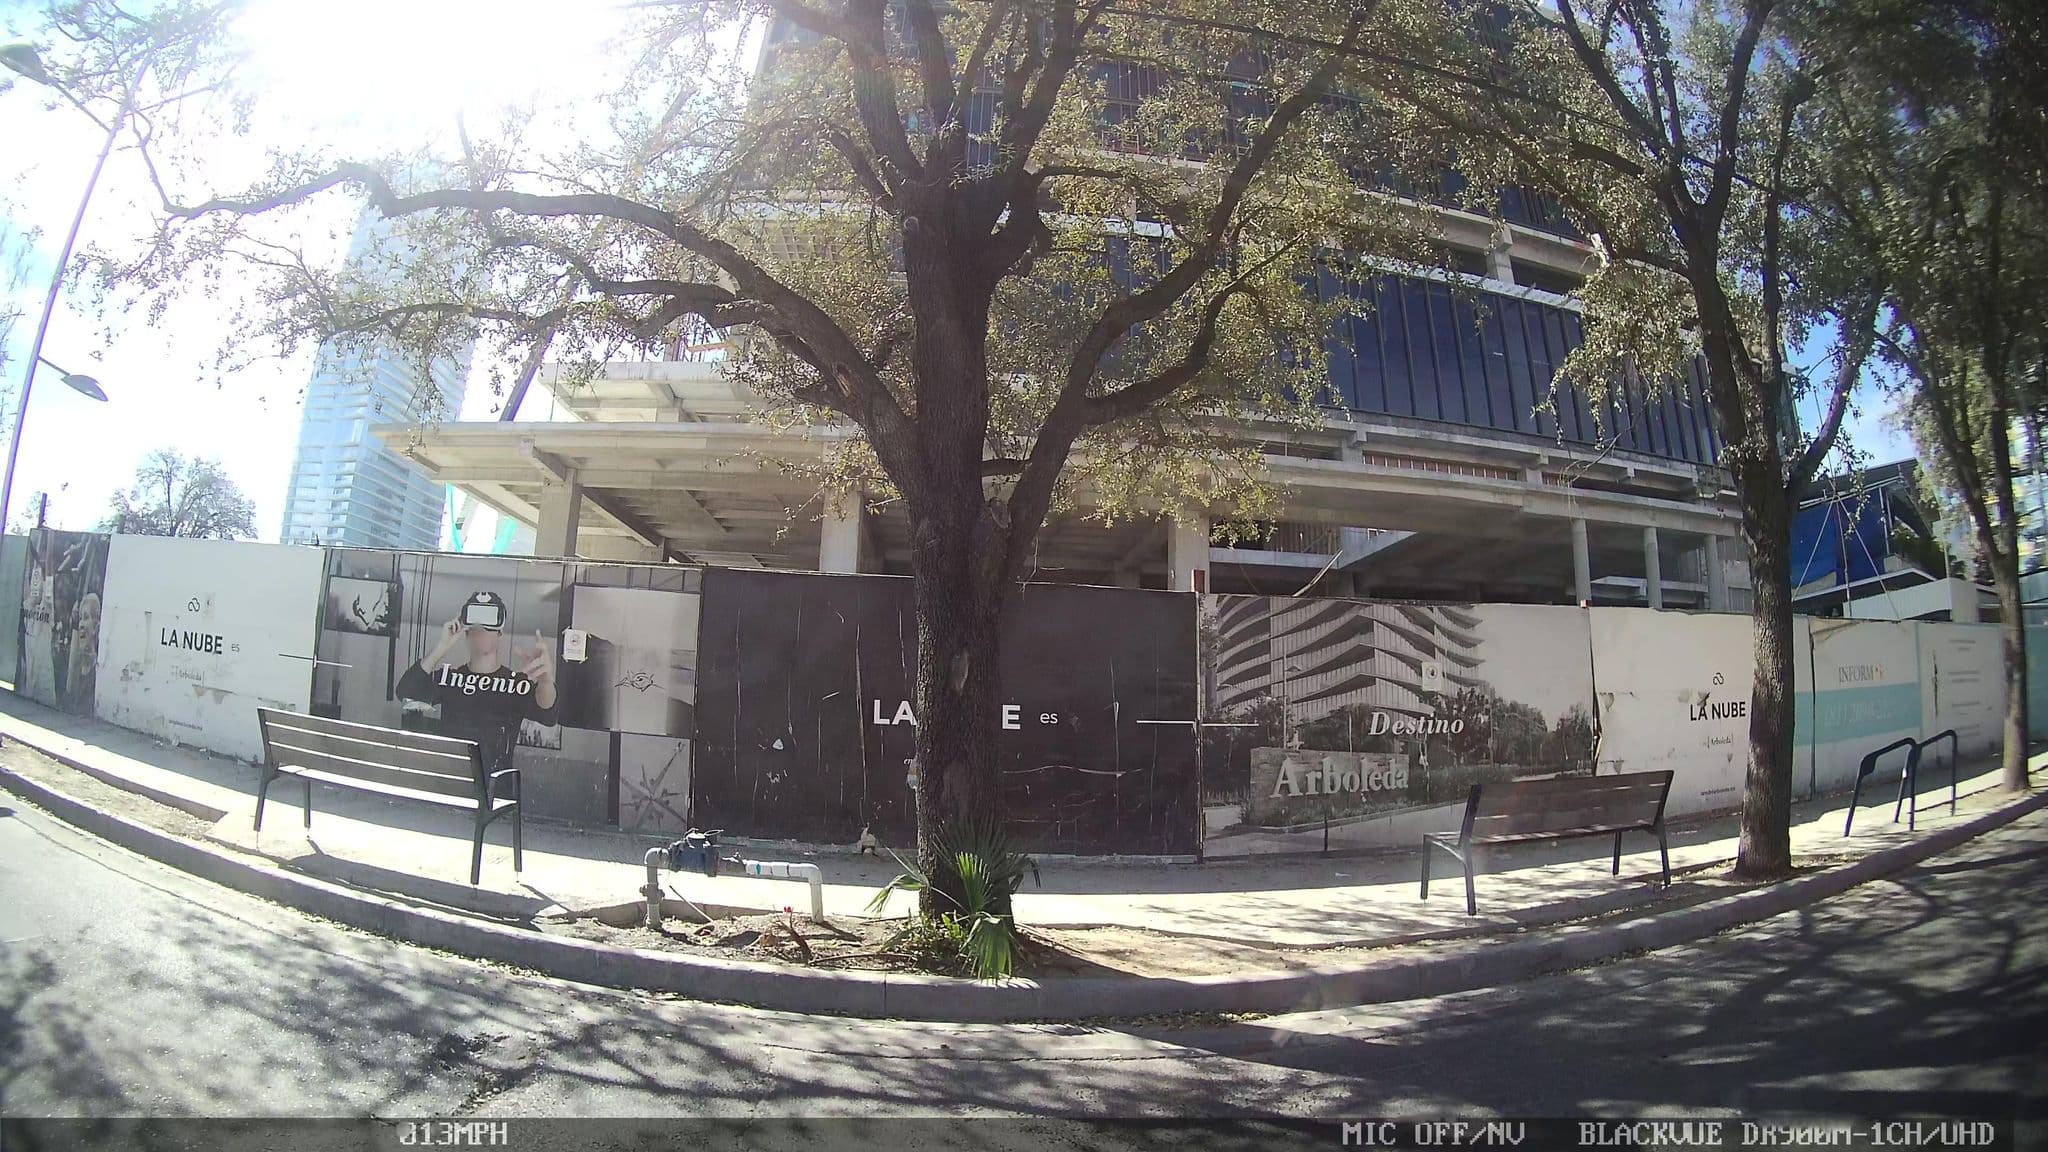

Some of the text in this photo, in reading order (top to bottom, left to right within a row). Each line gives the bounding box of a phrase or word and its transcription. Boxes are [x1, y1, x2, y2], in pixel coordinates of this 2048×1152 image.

[161, 627, 179, 648] LA
[182, 630, 223, 655] NUBE
[438, 663, 531, 695] Ingenio
[873, 699, 917, 726] LA
[1040, 712, 1058, 724] es
[1368, 711, 1465, 736] Destino
[1690, 701, 1746, 721] LA NUBE
[1269, 755, 1409, 798] Arboleda
